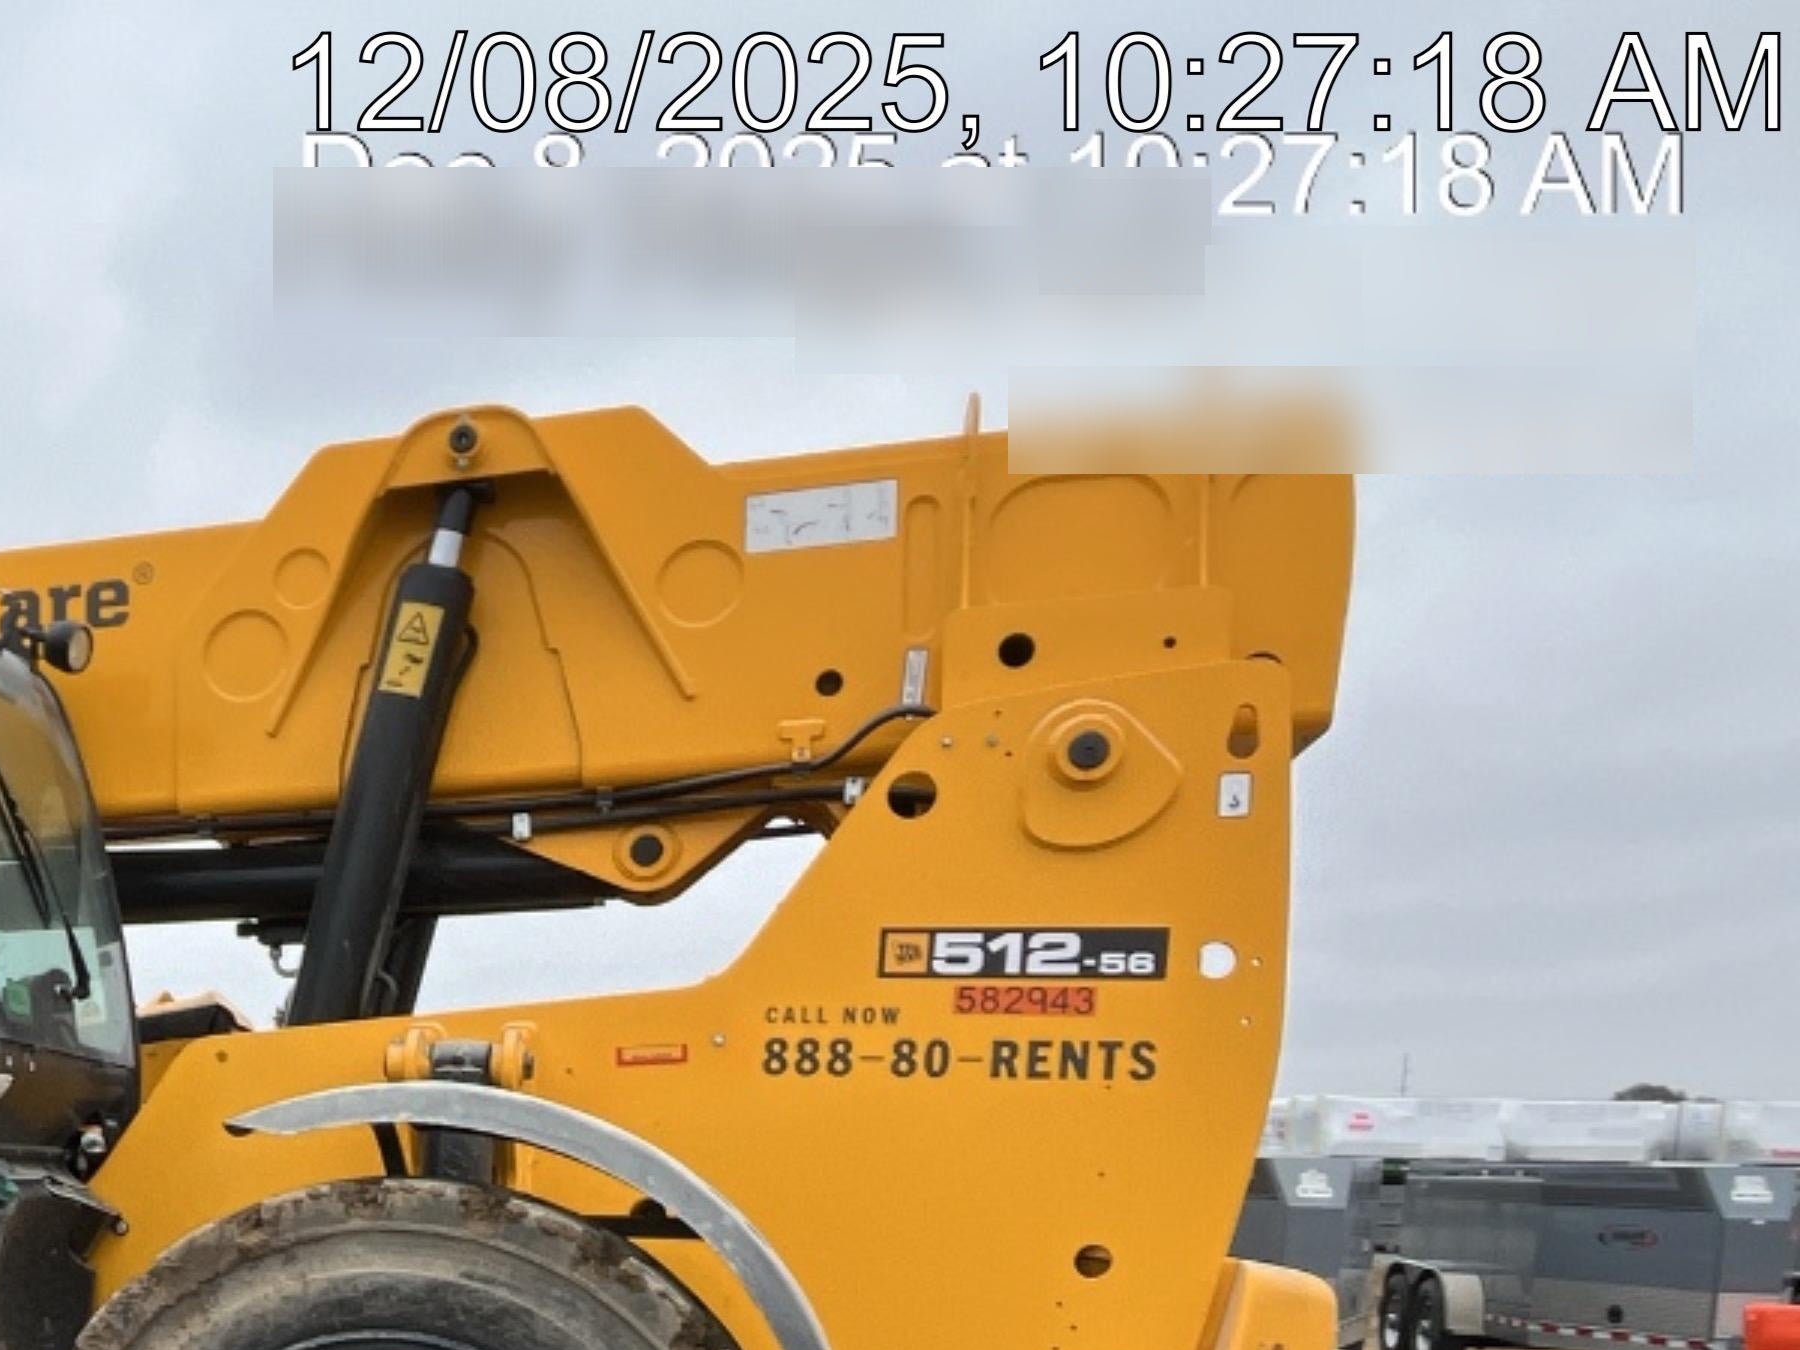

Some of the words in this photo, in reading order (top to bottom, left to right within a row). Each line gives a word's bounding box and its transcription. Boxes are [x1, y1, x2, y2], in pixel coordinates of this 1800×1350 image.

[931, 931, 1157, 976] 512-56
[764, 1006, 830, 1025] CALL
[842, 1007, 902, 1025] NOW
[955, 986, 1096, 1015] 582943
[761, 1037, 1158, 1081] 888-80-RENTS
